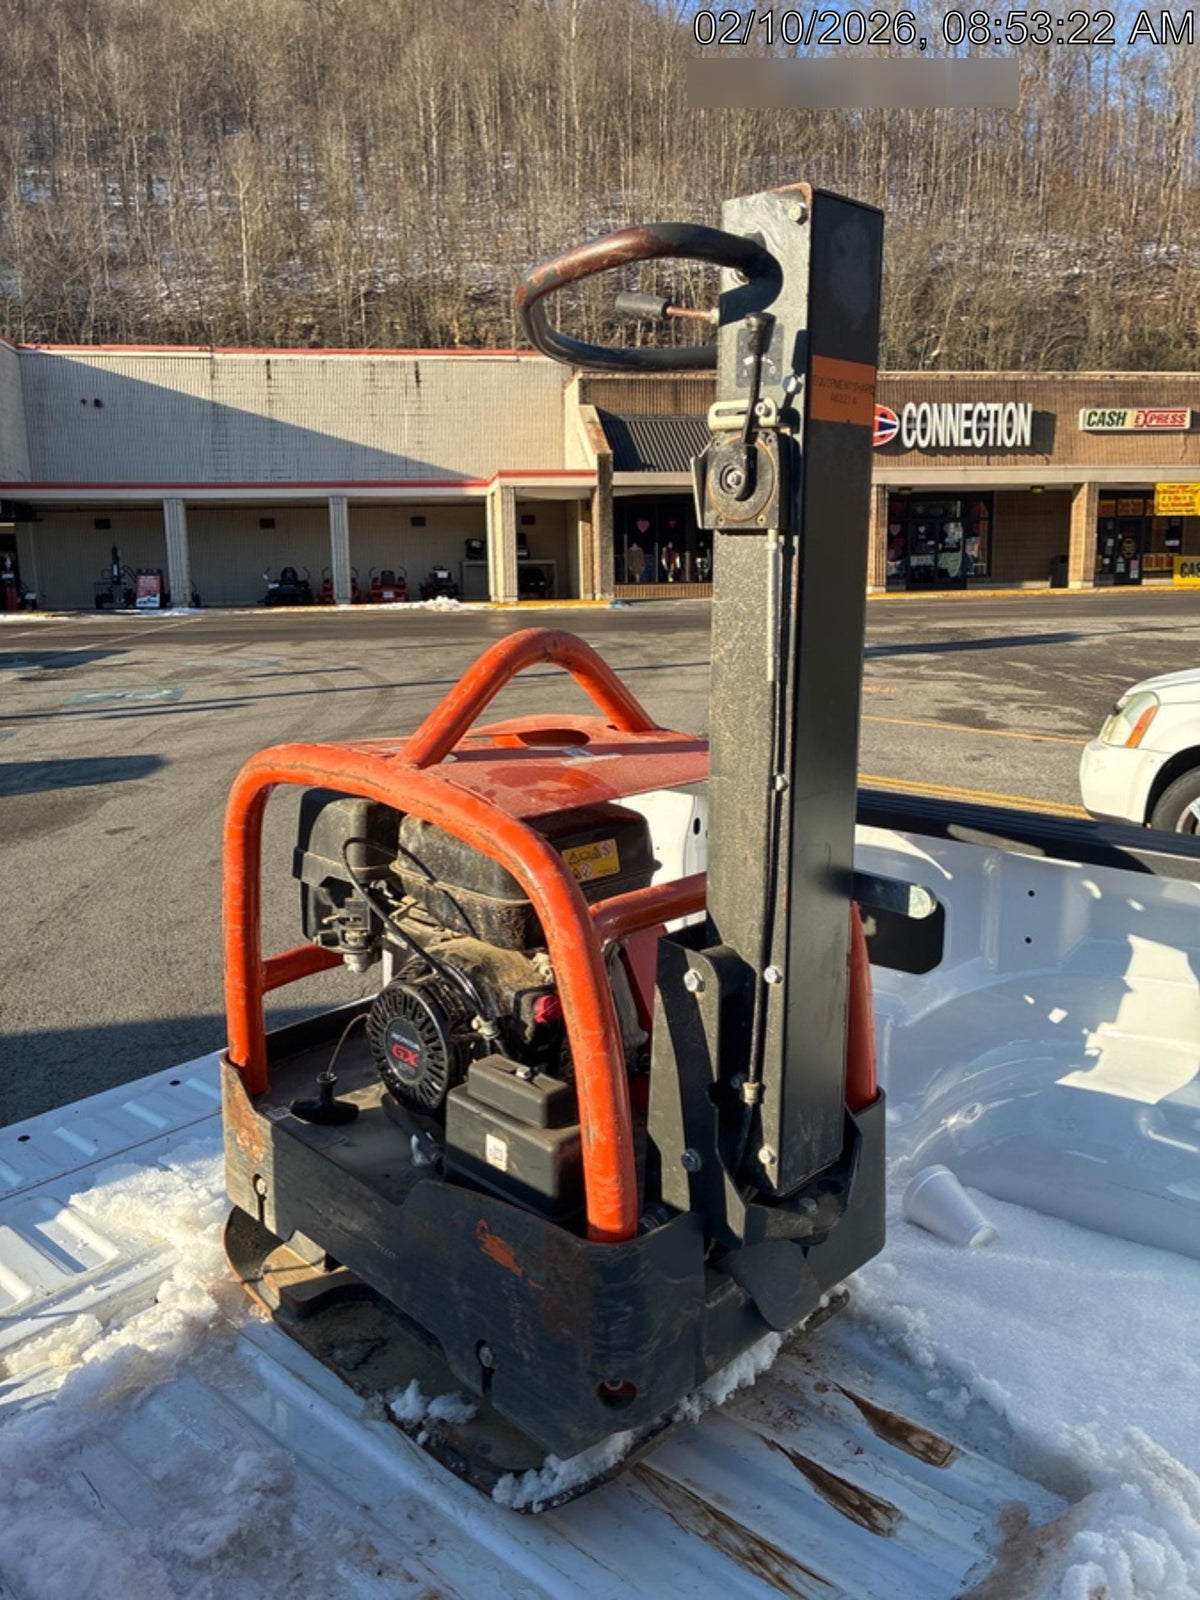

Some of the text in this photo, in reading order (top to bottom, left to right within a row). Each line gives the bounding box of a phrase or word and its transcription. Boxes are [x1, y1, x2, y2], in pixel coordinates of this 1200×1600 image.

[901, 402, 1033, 449] CONNECTION
[1086, 409, 1187, 428] CASH EXPRESS
[392, 1044, 420, 1068] GX
